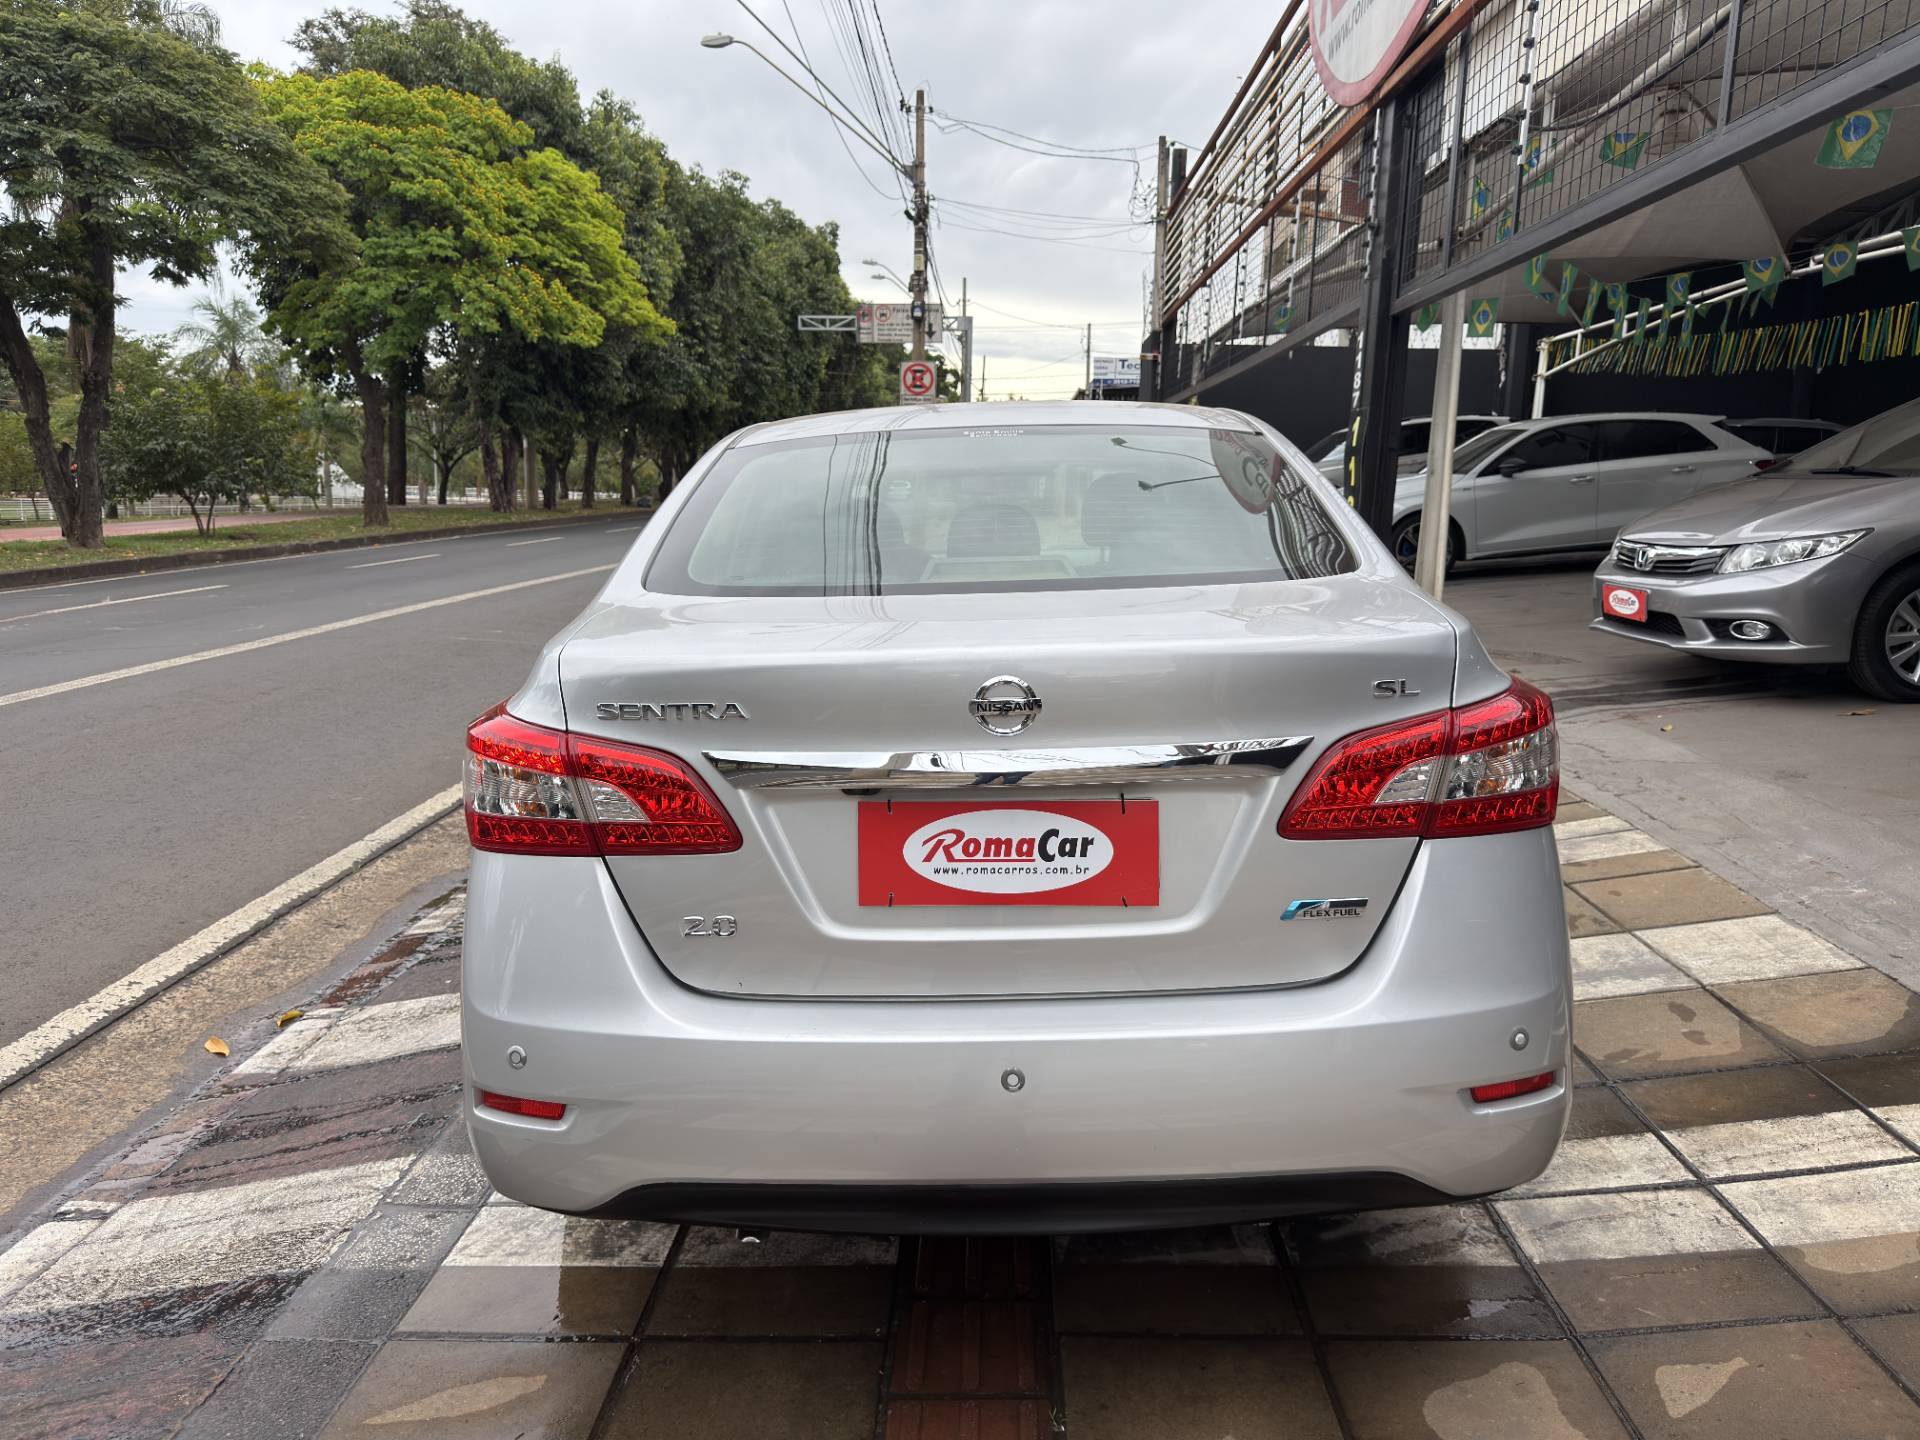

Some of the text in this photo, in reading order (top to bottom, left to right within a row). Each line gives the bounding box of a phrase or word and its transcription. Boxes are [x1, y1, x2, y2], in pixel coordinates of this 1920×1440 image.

[1352, 331, 1364, 409] 1187
[1374, 679, 1421, 698] SL
[596, 702, 750, 720] SENTRA
[976, 702, 1034, 713] NISSAN
[921, 828, 1095, 863] RomaCar
[933, 864, 1090, 875] www.romacarros.com.br
[1303, 908, 1361, 918] FLEX FUEL
[683, 915, 738, 937] 2.0
